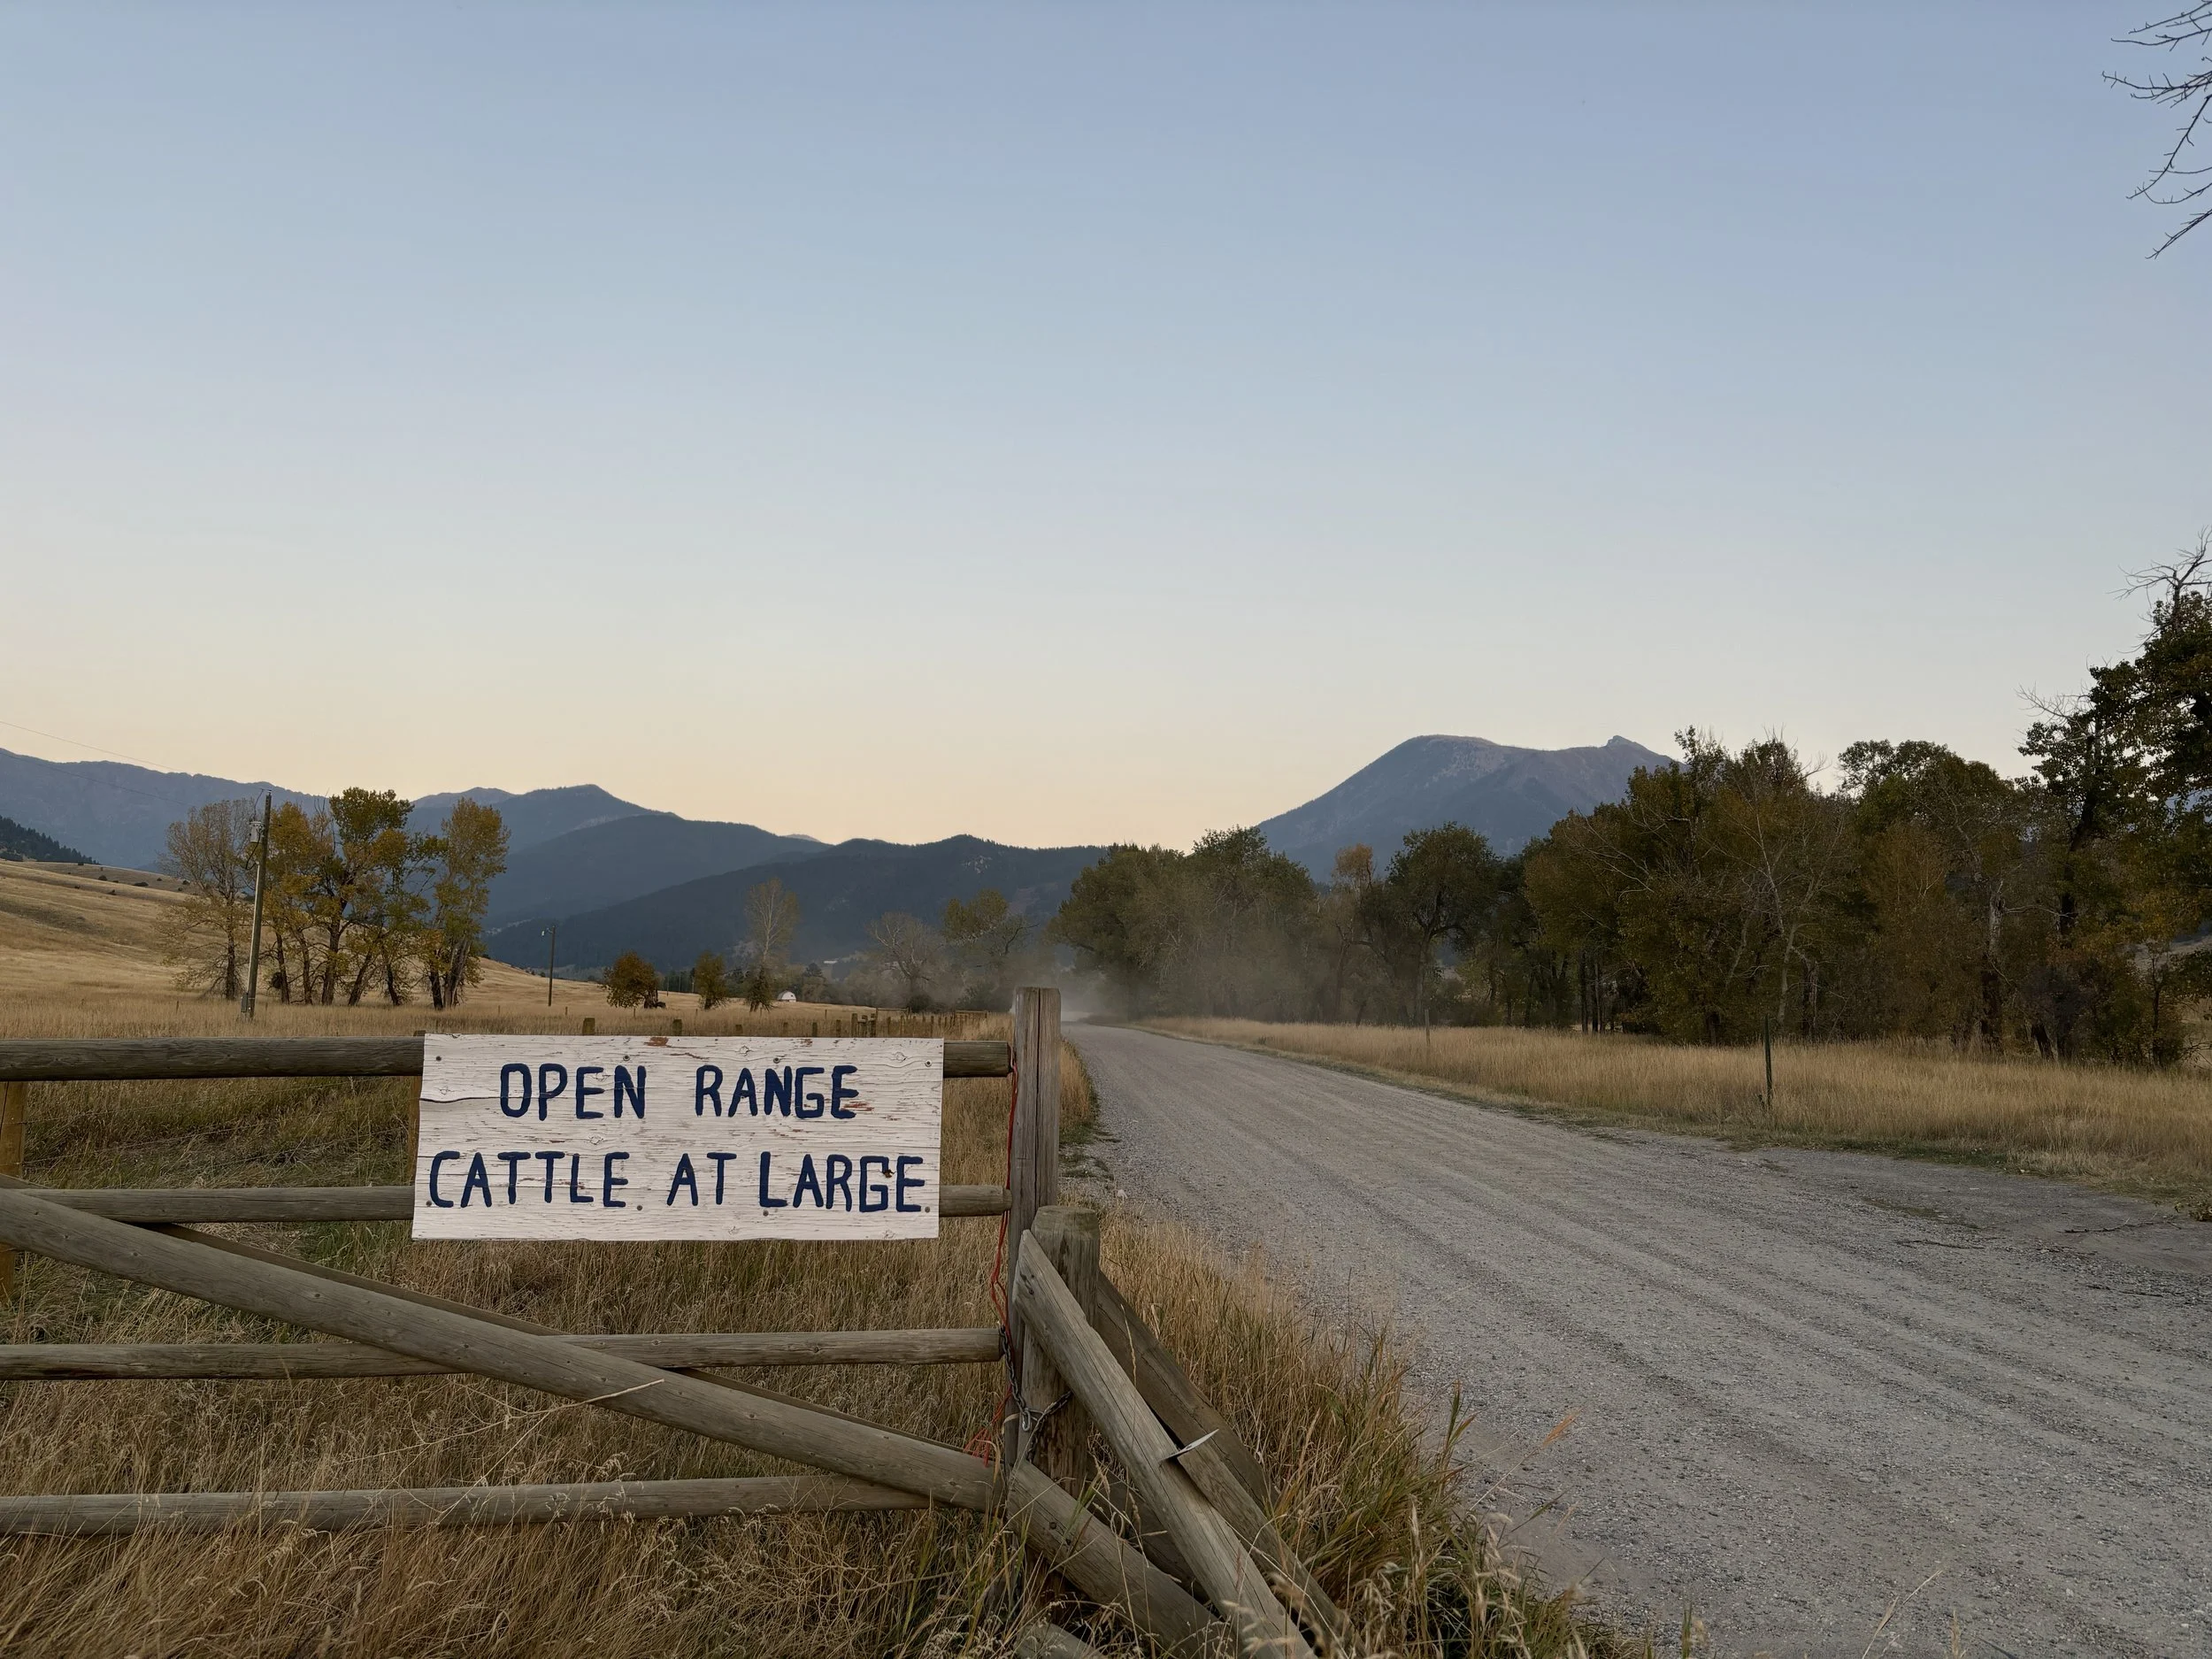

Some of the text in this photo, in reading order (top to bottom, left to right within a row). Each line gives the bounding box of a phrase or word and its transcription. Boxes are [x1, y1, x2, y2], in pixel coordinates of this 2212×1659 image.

[500, 1063, 858, 1120] OPEN RANGE
[428, 1150, 925, 1213] CATTLE AT LARGE
